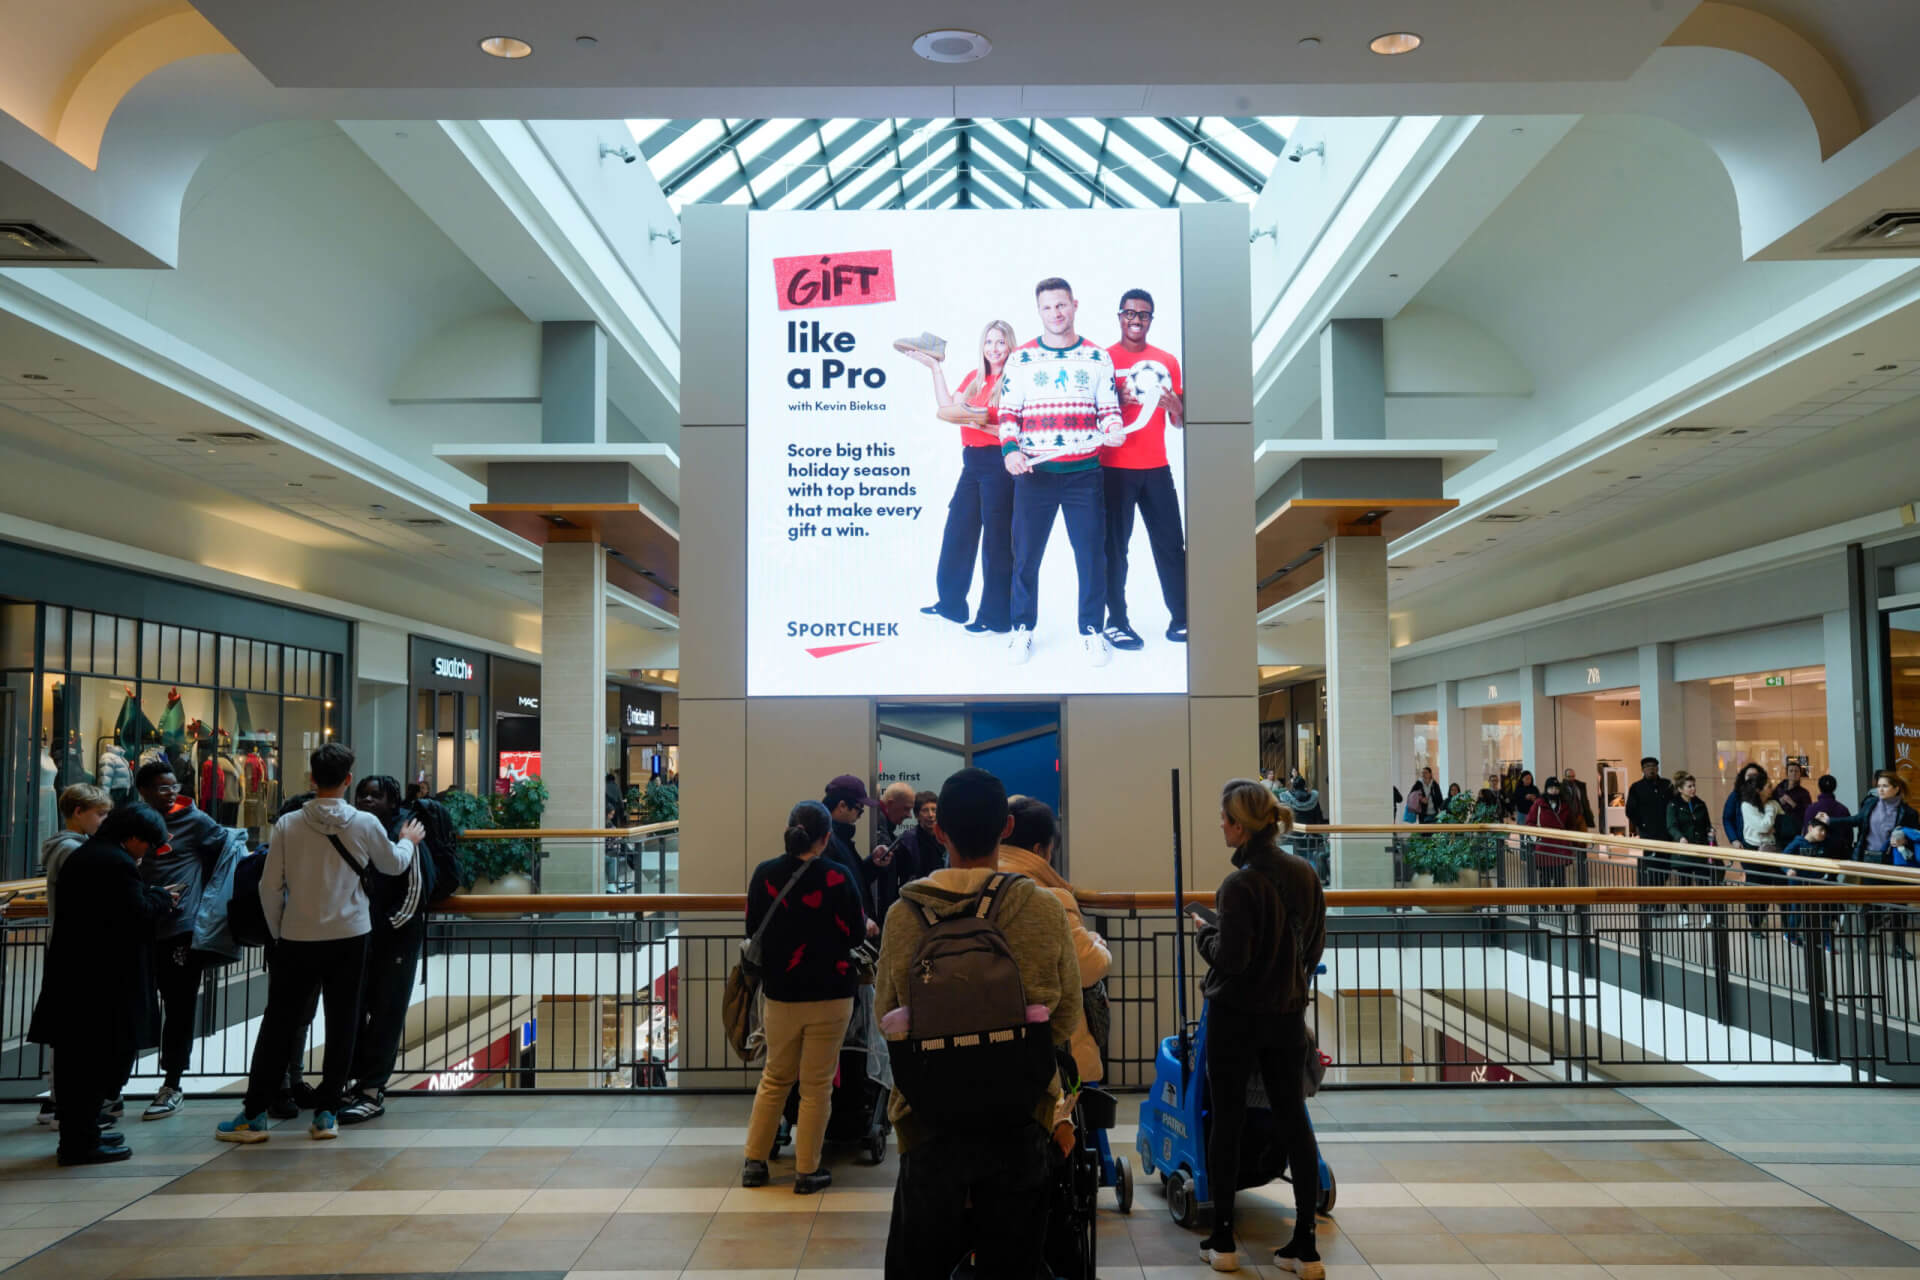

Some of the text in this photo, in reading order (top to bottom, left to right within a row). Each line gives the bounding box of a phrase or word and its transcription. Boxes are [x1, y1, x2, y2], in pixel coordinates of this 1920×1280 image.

[787, 320, 856, 354] like
[787, 359, 887, 390] a Pro
[788, 400, 887, 411] with Kevin Bieksa
[787, 442, 896, 462] Score big this
[787, 463, 911, 481] holiday season
[787, 481, 917, 501] with top brands
[787, 502, 923, 521] that make every
[787, 521, 870, 542] gift a win.
[435, 656, 468, 681] swatch
[898, 772, 921, 782] first
